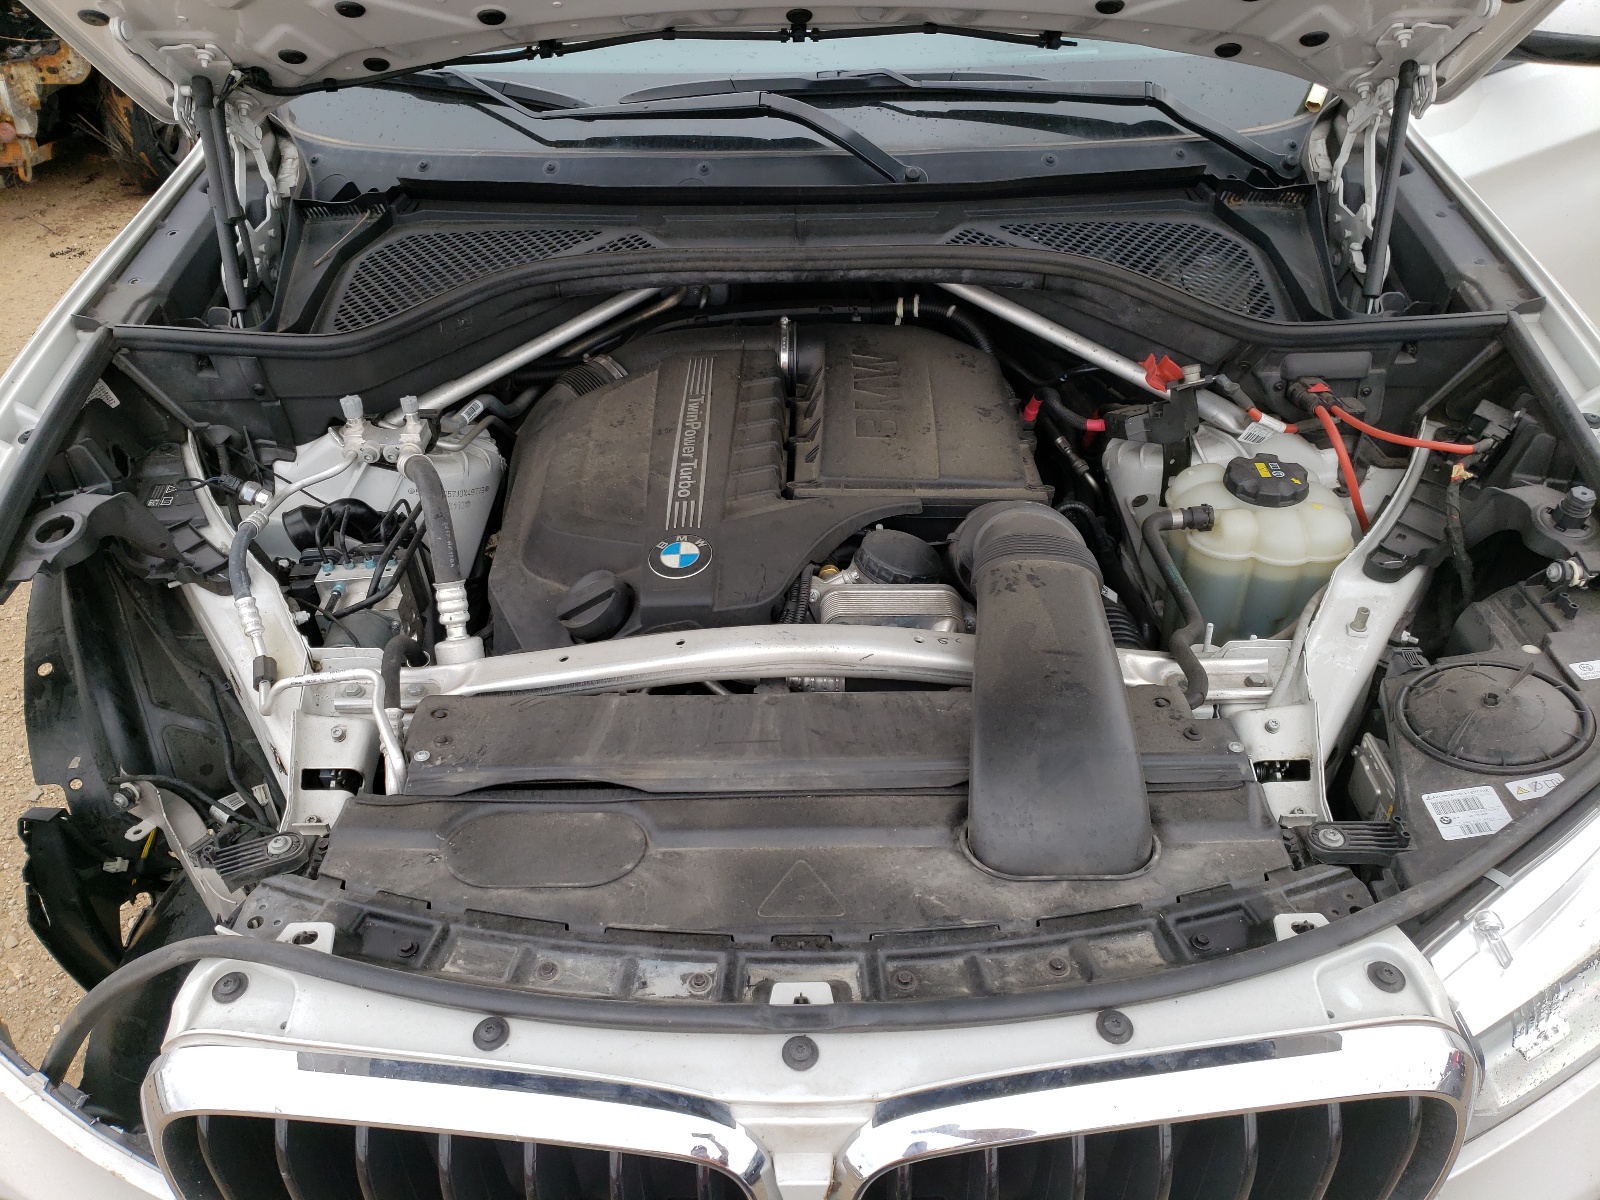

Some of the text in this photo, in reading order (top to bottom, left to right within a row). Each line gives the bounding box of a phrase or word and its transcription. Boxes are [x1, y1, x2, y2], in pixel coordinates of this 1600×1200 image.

[851, 348, 901, 439] BMW
[677, 395, 705, 498] TwinPower Turbo
[656, 535, 707, 549] BMW
